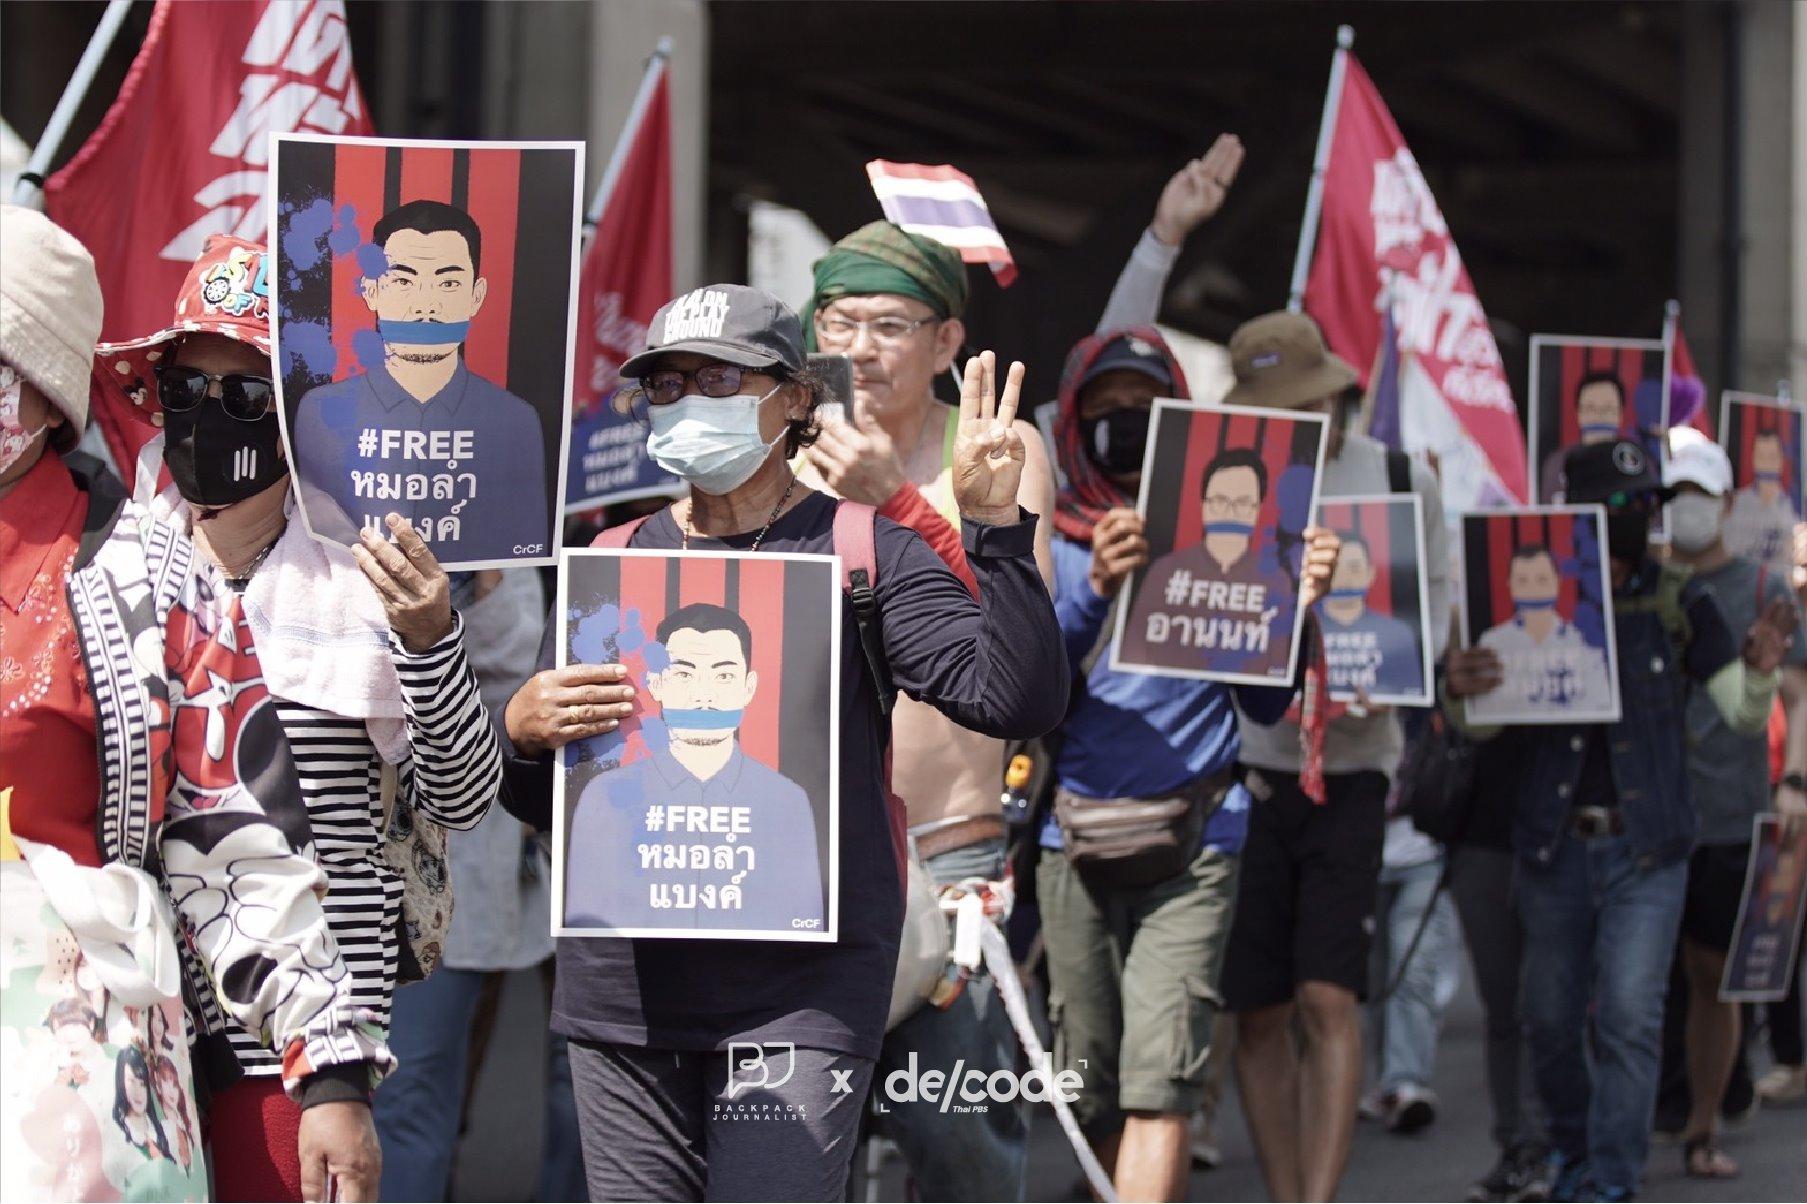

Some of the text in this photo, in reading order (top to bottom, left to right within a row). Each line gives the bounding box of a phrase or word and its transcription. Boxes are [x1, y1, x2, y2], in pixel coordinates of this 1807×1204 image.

[358, 429, 474, 459] #FREE
[351, 459, 476, 500] หมอลำ
[1164, 569, 1267, 613] #FREE
[1146, 606, 1278, 654] อานนท์
[645, 805, 752, 833] #FREE
[638, 833, 755, 870] หมอลำ
[649, 870, 747, 909] แบงค์
